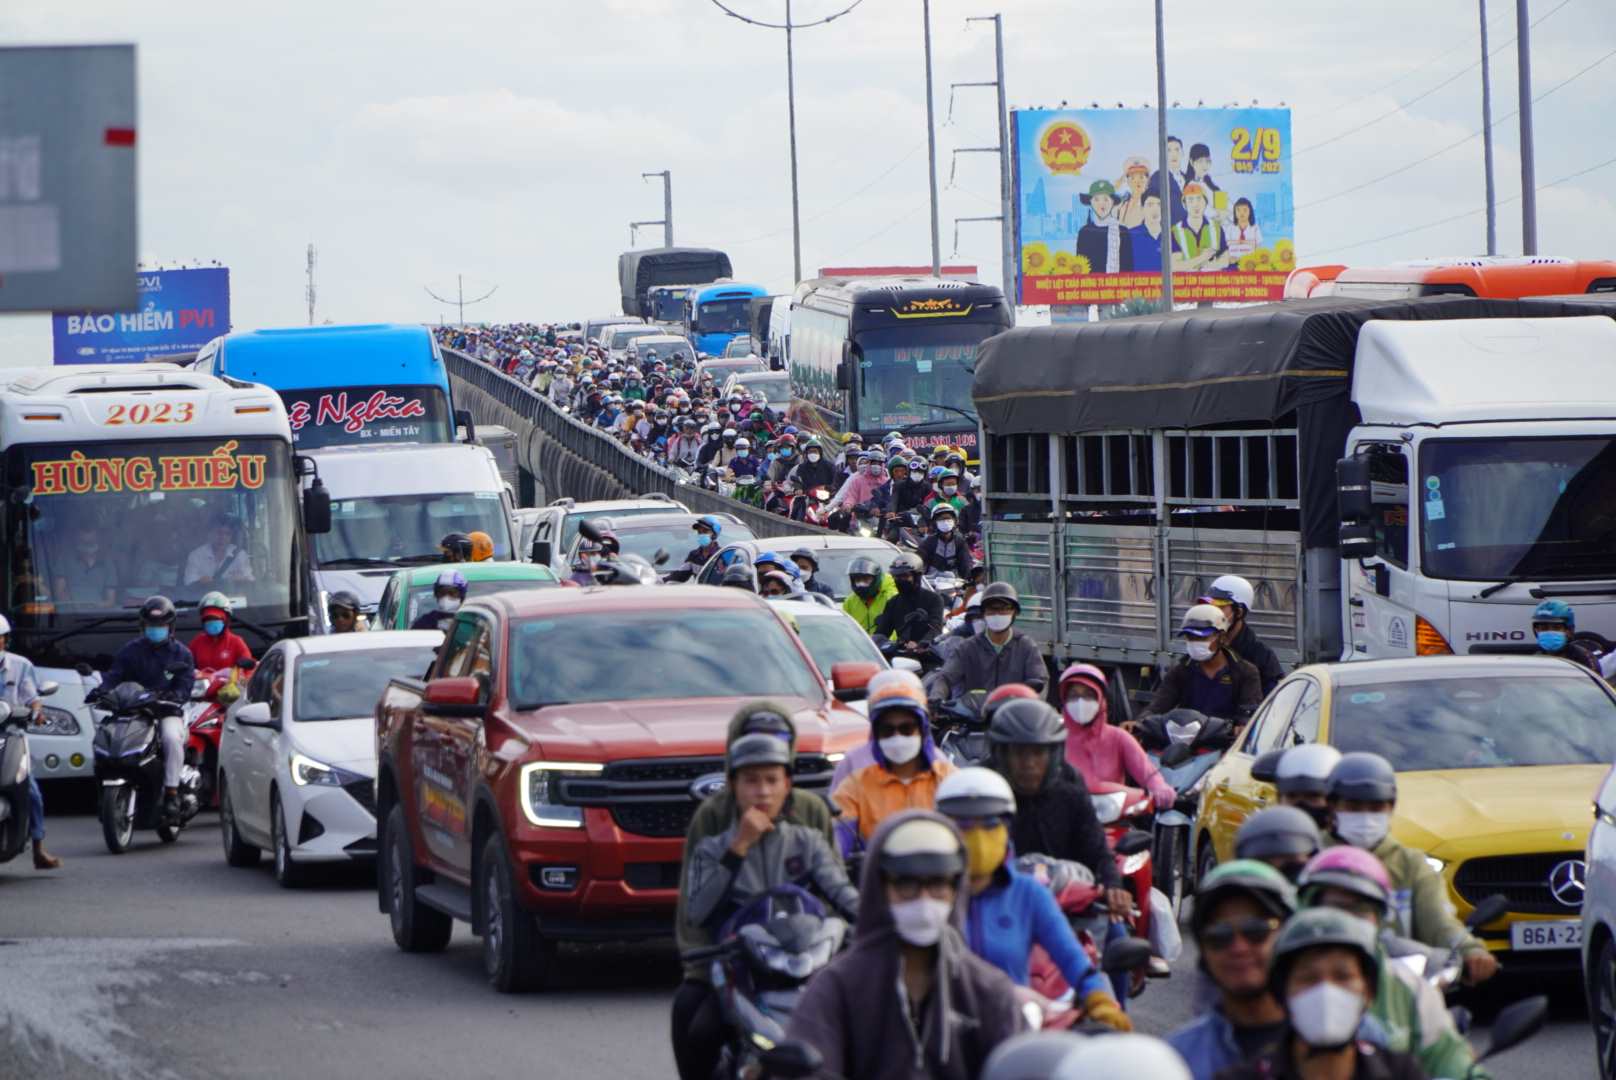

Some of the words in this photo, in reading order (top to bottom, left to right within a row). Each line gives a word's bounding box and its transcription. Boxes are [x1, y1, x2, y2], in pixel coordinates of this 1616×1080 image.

[1231, 127, 1281, 161] 2/9
[120, 301, 174, 333] HIỂM
[178, 307, 215, 329] PVI
[103, 402, 196, 426] 2023
[316, 390, 425, 434] Nghĩa
[402, 425, 420, 437] TÂY
[31, 450, 156, 496] HÙNG
[158, 440, 268, 491] HIẾU
[1465, 630, 1526, 642] HINO
